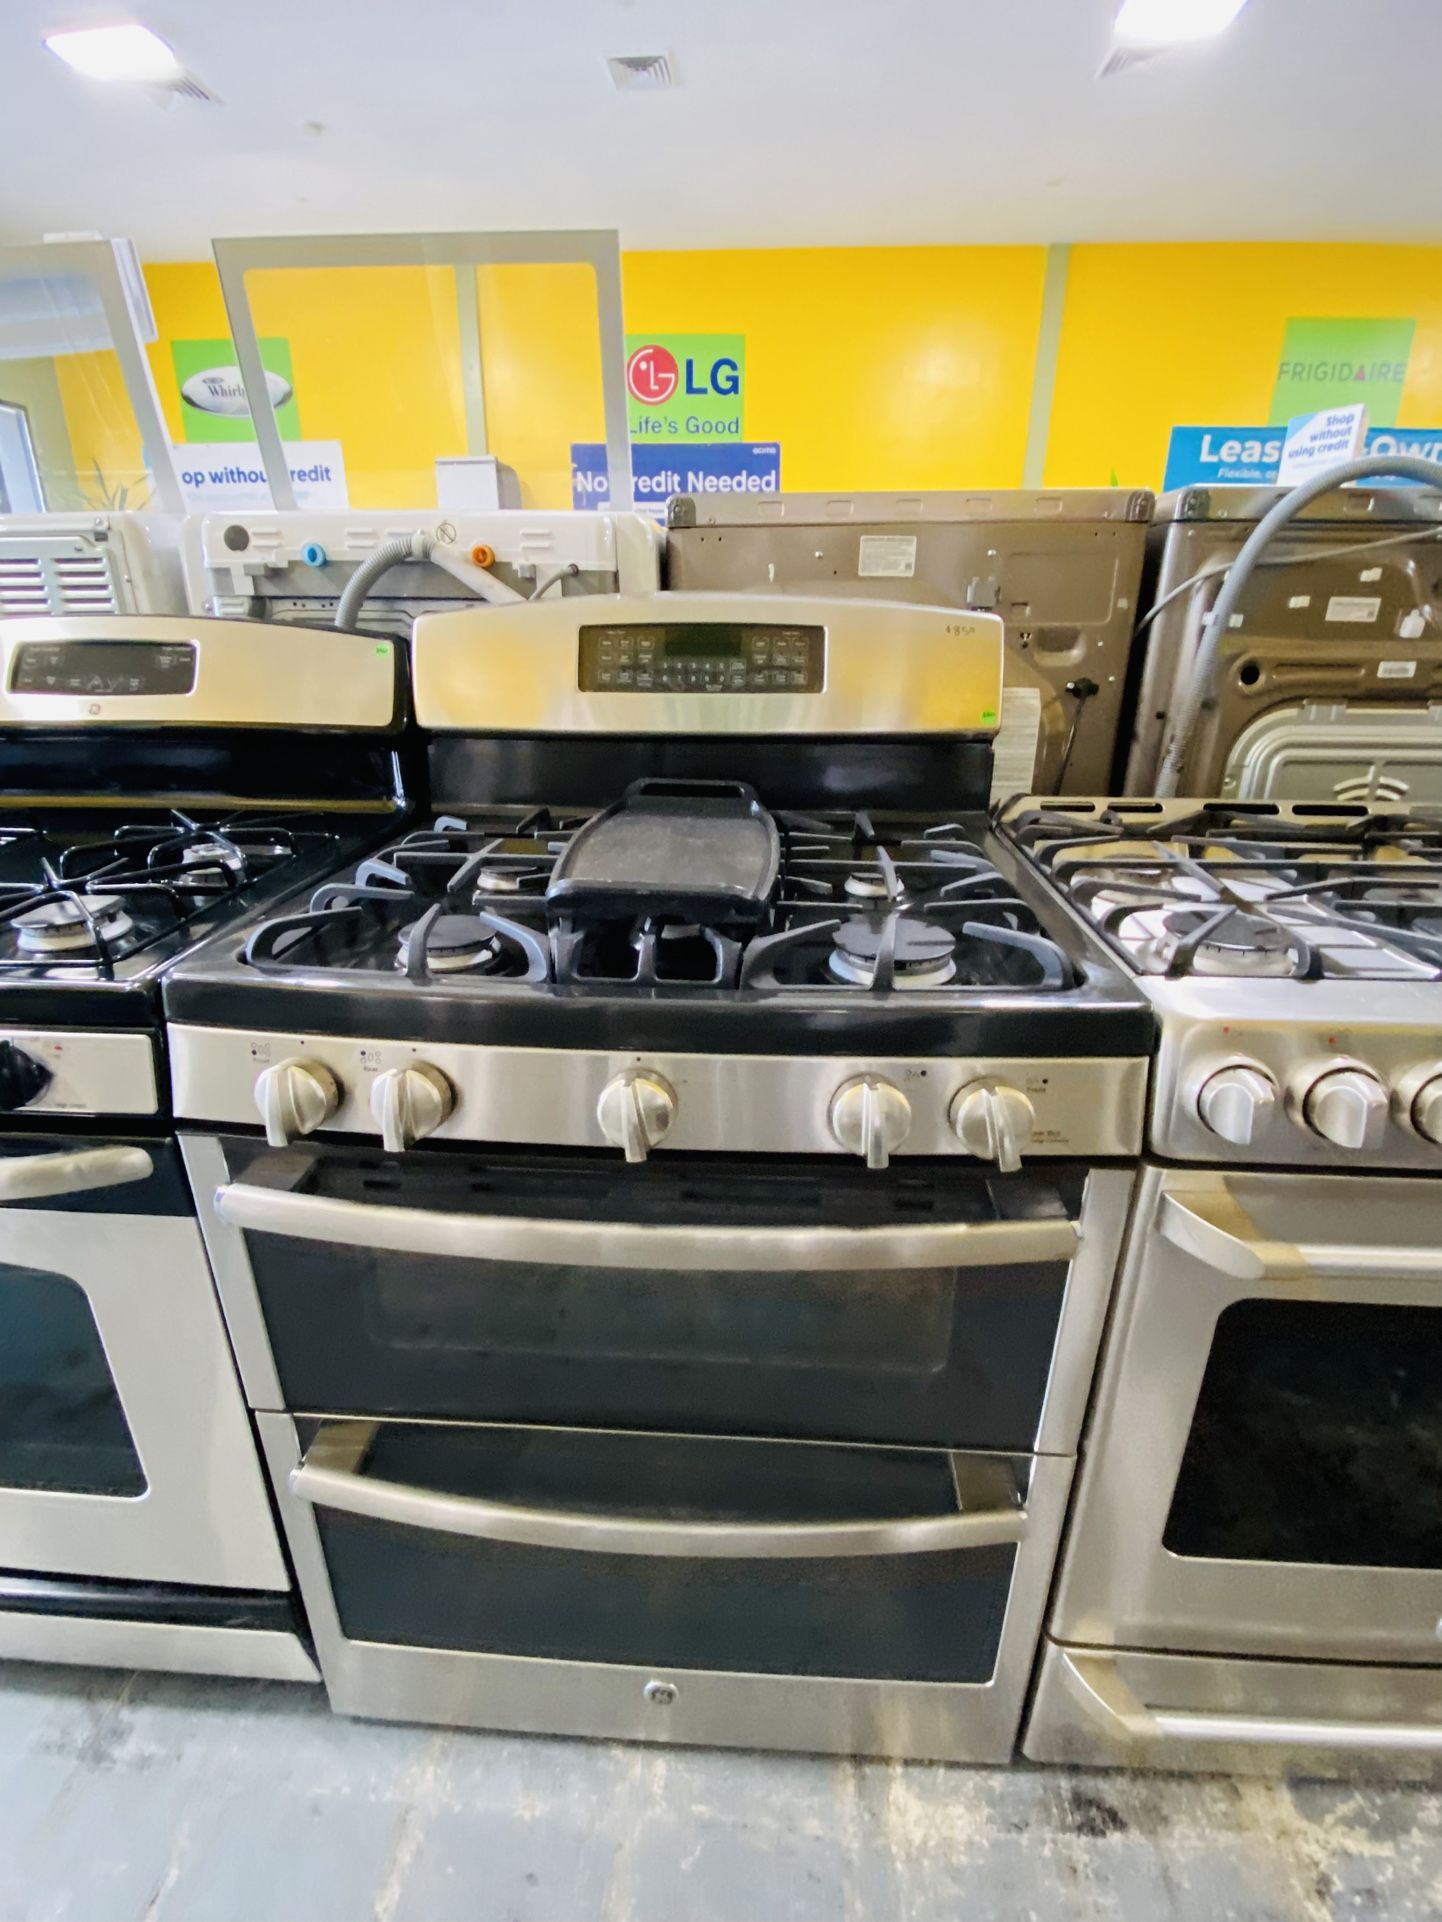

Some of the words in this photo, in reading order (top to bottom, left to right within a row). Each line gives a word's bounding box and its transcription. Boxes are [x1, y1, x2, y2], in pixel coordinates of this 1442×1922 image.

[686, 358, 740, 396] LG
[1277, 361, 1407, 382] FRIGIDAIRE
[630, 416, 678, 434] ife's
[686, 416, 740, 434] Good
[1327, 413, 1355, 427] Shop
[1310, 427, 1353, 442] without
[1199, 434, 1282, 463] Leas
[1288, 445, 1316, 458] using
[1317, 439, 1350, 452] credit
[181, 471, 206, 488] op
[208, 466, 267, 484] withou
[291, 464, 332, 482] redit
[576, 471, 608, 493] No
[633, 470, 681, 493] redit
[687, 470, 776, 493] Needed
